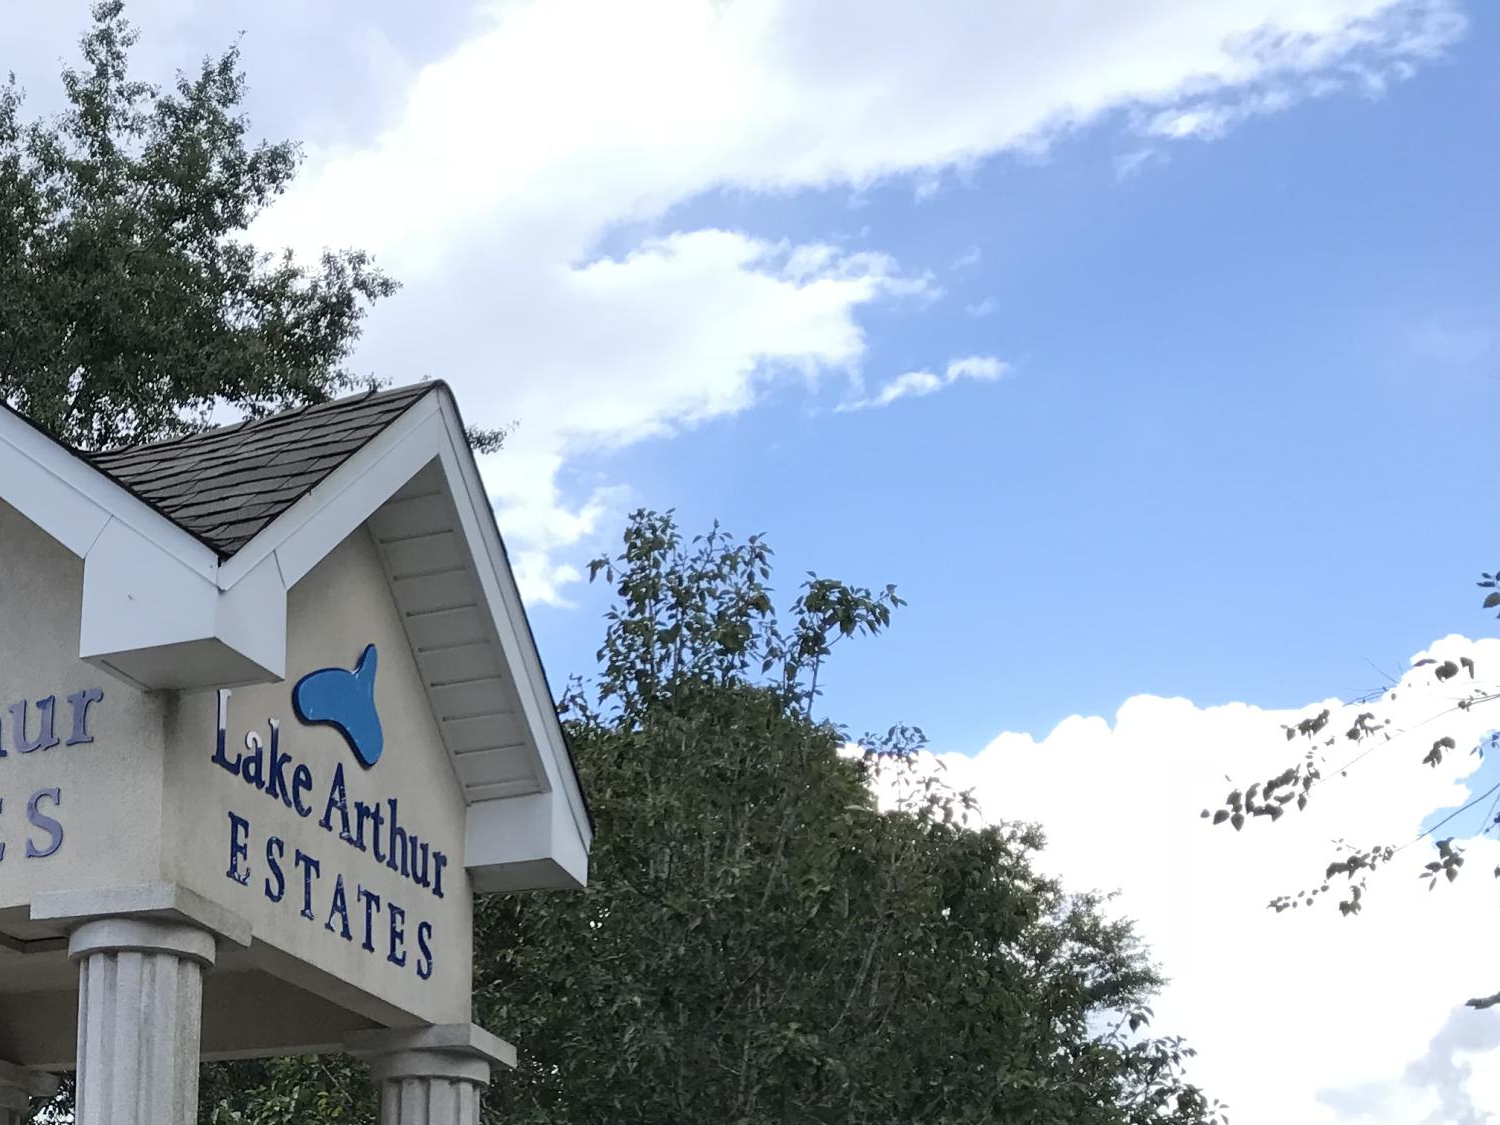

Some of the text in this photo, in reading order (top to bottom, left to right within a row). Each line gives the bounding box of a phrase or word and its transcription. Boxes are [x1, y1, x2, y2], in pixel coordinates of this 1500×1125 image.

[211, 688, 448, 898] Lake Arthur
[226, 811, 433, 980] ESTATES
